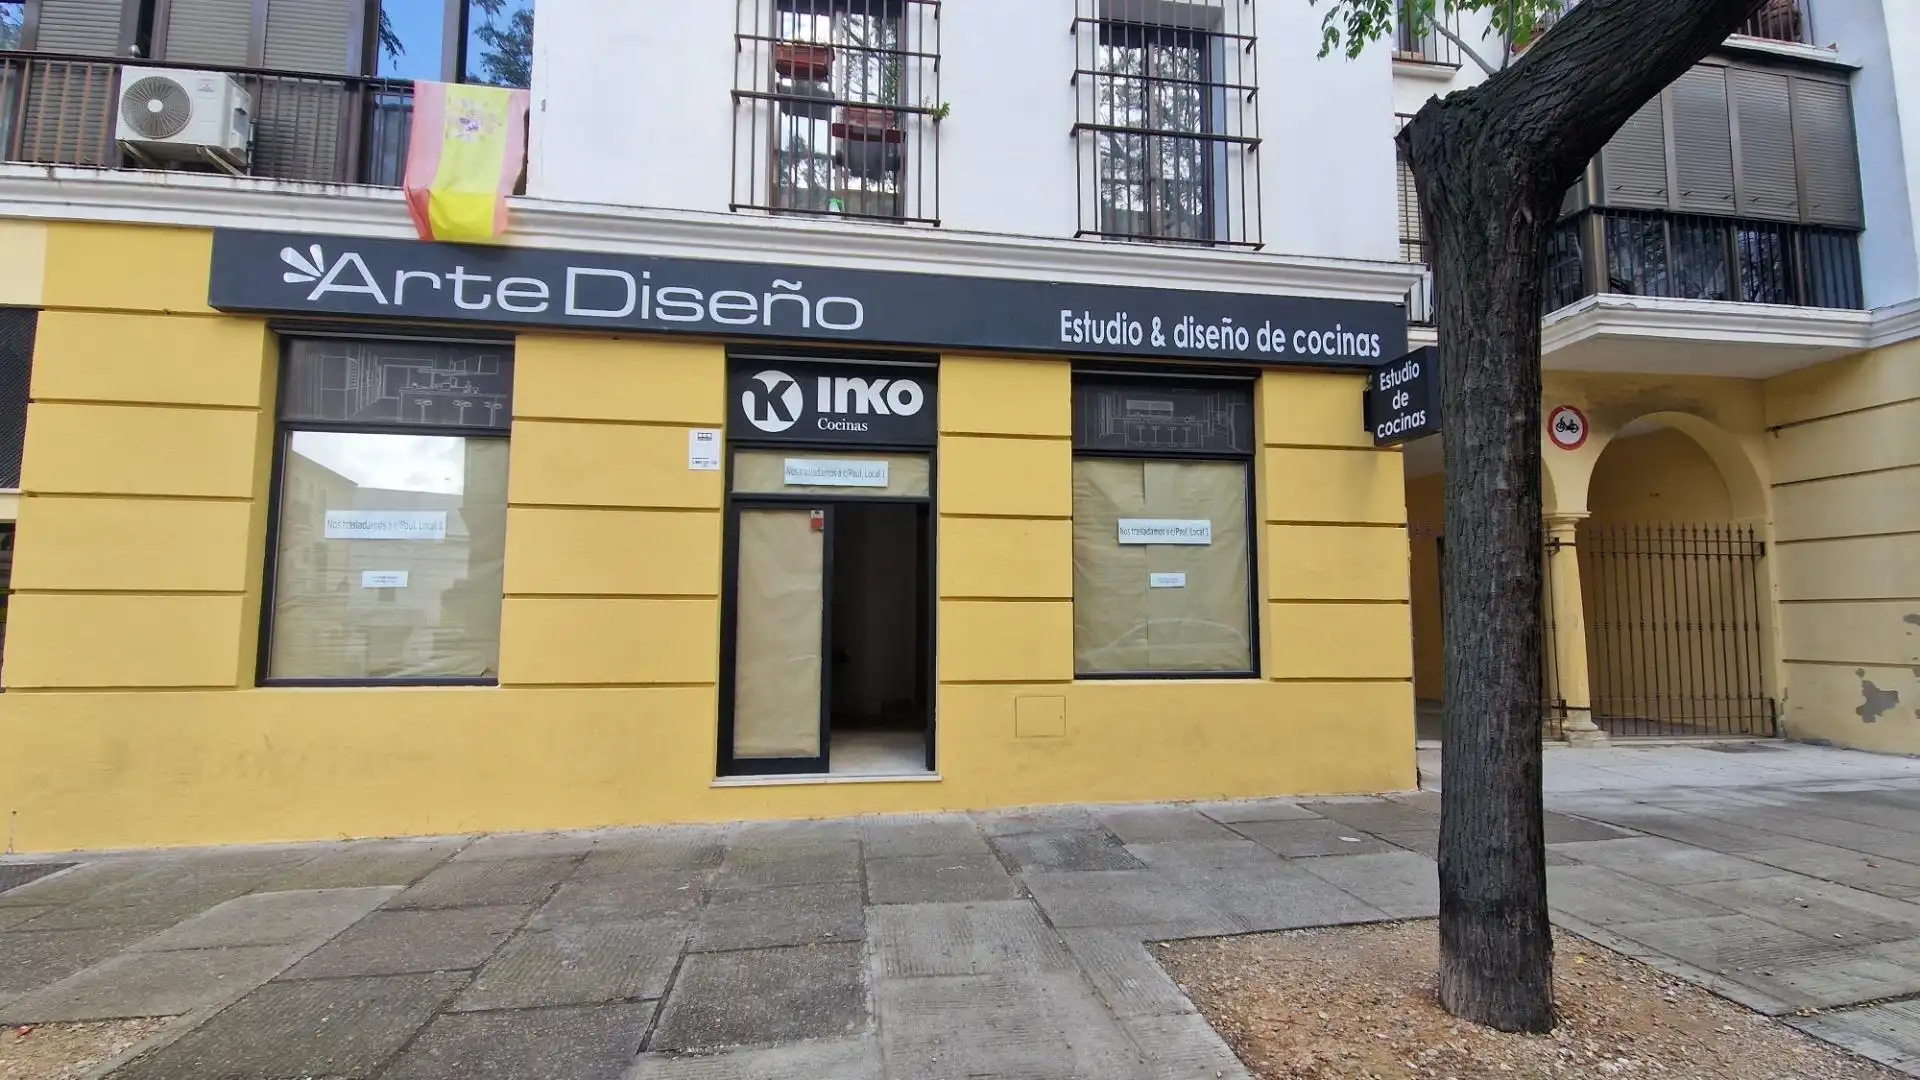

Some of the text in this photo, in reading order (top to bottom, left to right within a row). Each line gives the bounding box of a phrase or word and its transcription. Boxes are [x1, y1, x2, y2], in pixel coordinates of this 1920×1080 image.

[1061, 309, 1381, 357] Estudio & diseño de cocinas
[1380, 360, 1420, 391] Estudio
[1392, 389, 1409, 409] de
[817, 417, 868, 431] Cocinas
[1377, 409, 1426, 438] cocinas
